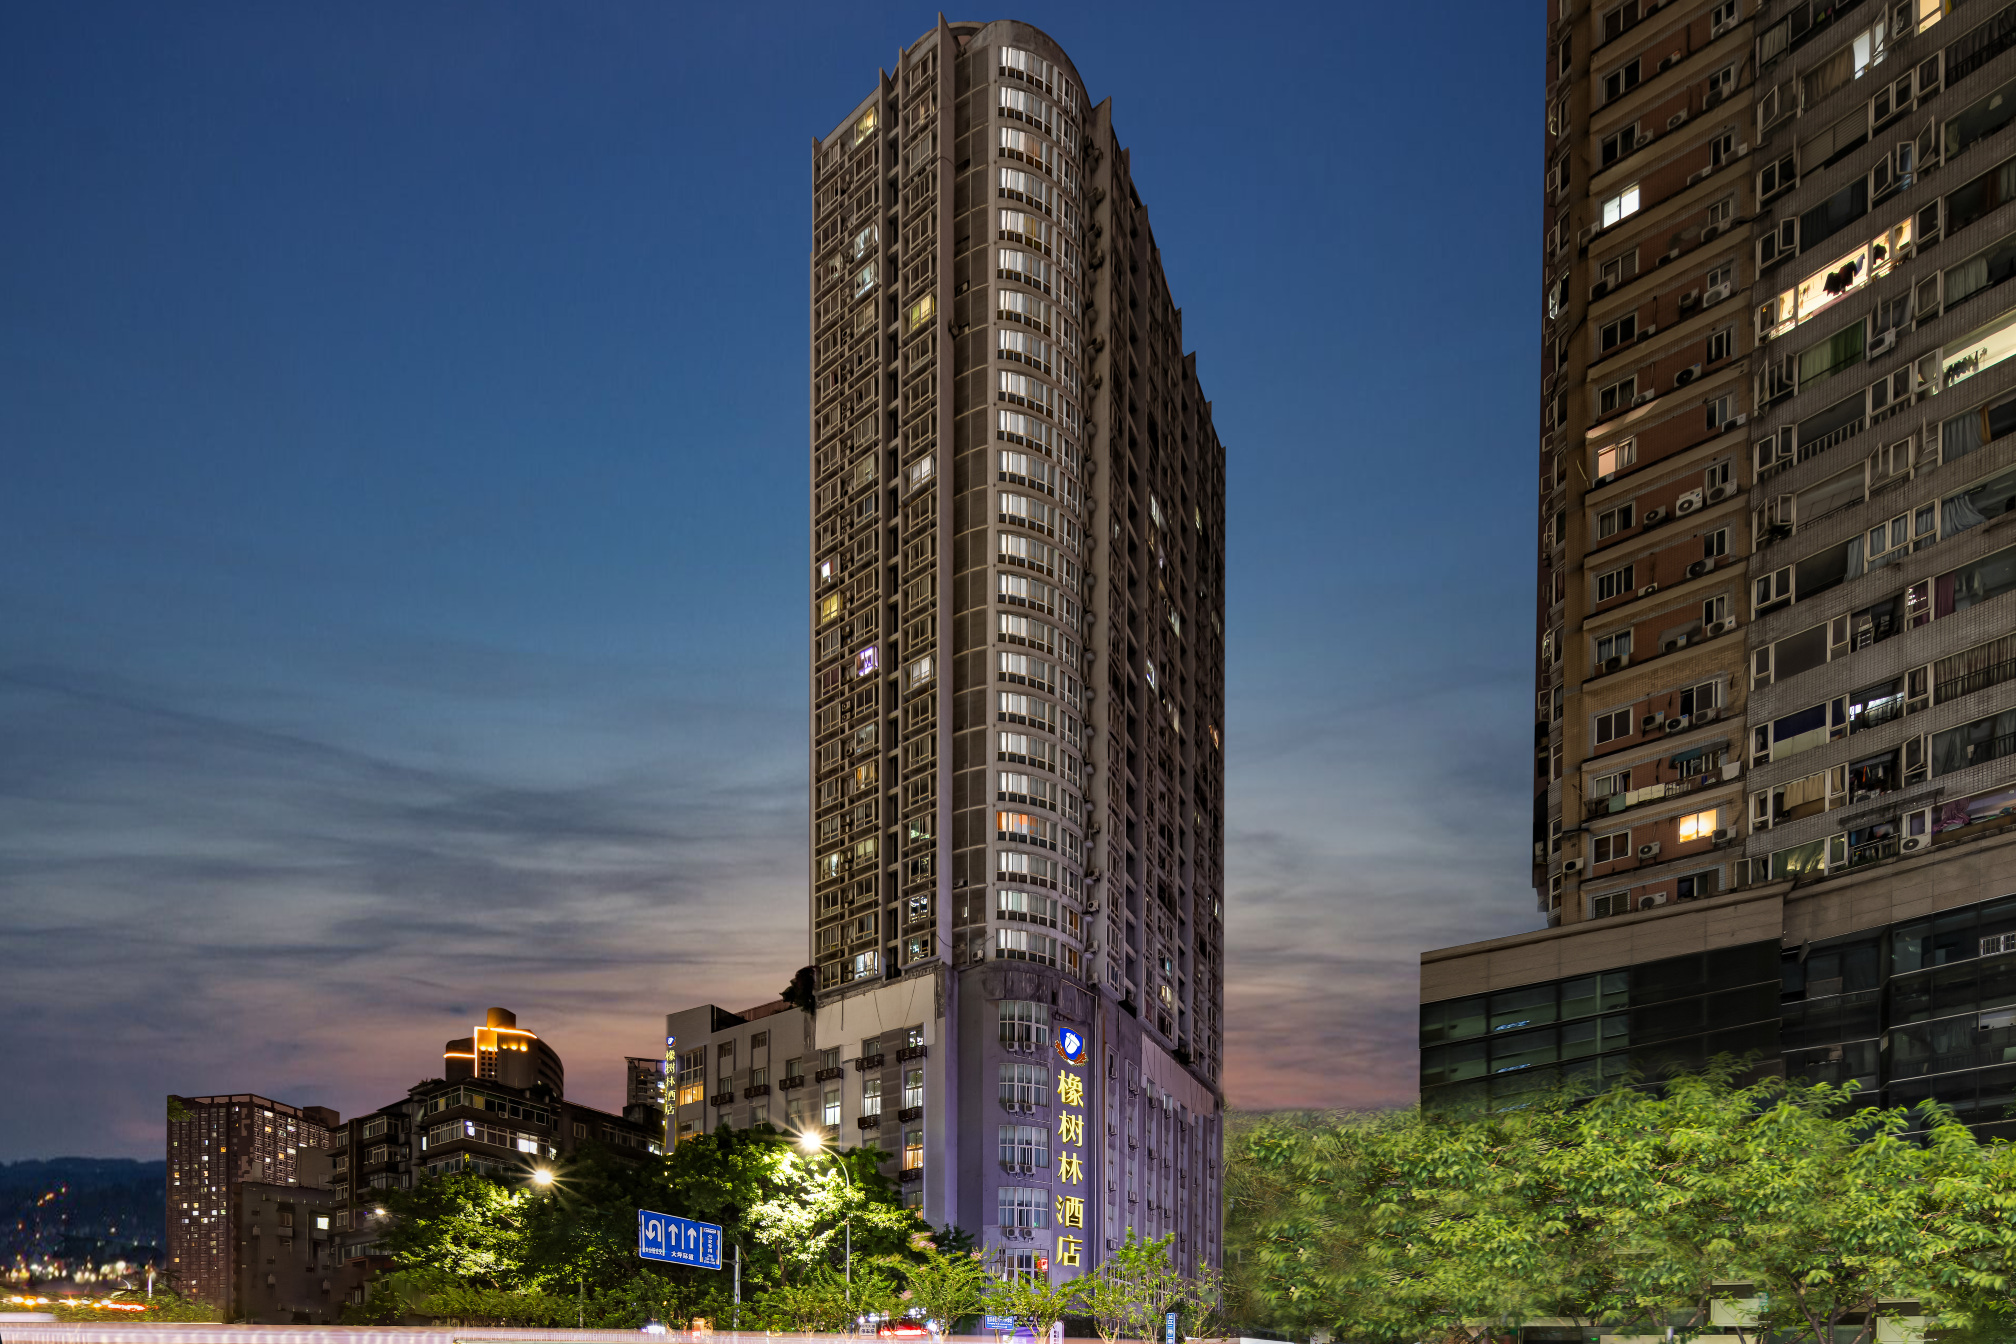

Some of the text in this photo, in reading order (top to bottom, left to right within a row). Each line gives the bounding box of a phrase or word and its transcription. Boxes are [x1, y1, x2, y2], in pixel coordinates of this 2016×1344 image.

[664, 1049, 676, 1116] 橡树林酒店
[1055, 1069, 1085, 1268] 橡树林酒店
